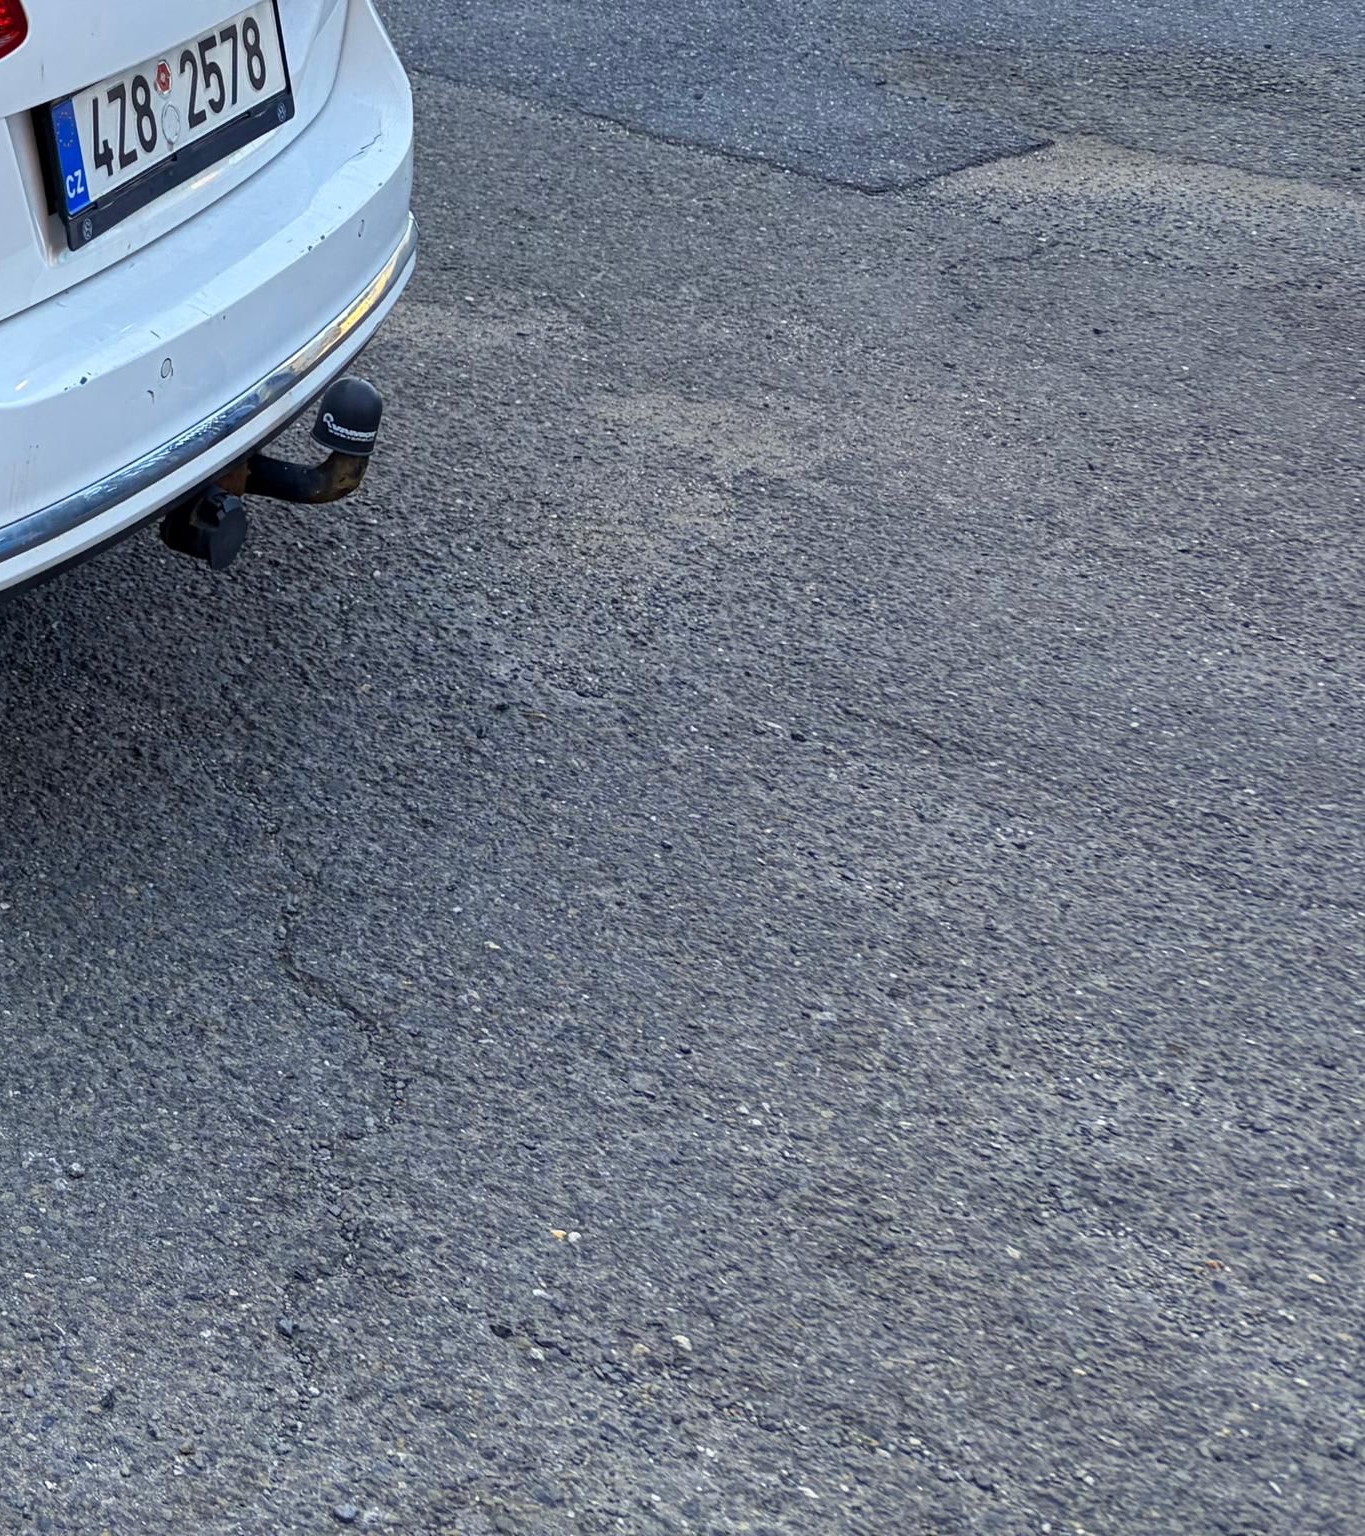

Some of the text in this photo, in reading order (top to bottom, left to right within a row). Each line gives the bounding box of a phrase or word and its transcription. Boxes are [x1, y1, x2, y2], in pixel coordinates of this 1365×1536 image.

[92, 16, 267, 177] 4Z8 2578
[66, 169, 85, 199] CZ
